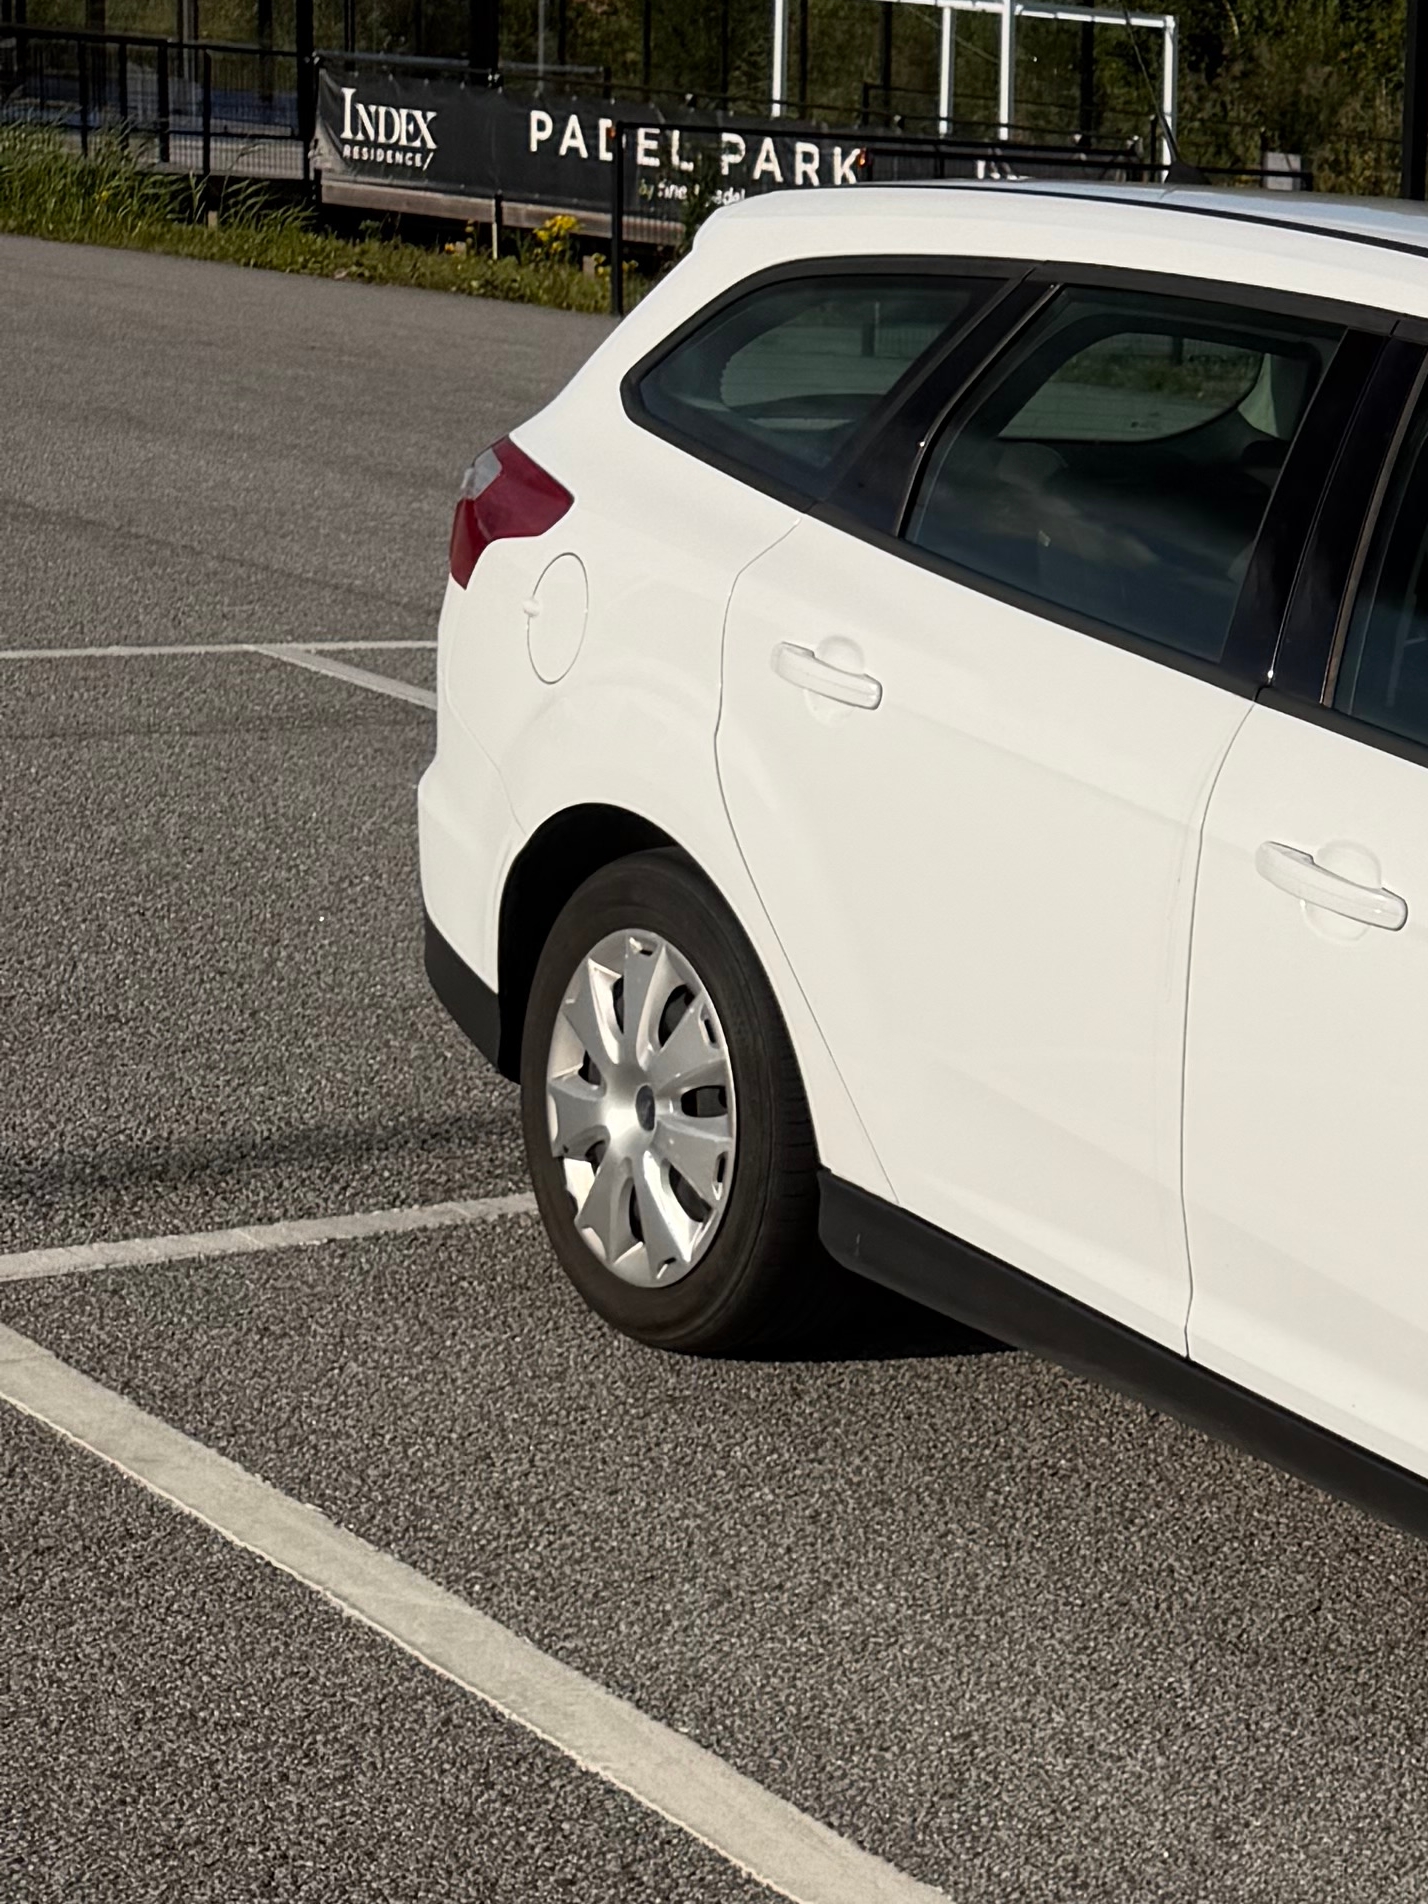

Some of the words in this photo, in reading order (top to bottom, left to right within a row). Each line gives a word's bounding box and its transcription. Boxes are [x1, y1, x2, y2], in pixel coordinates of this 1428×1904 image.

[340, 86, 438, 149] INDEX
[529, 109, 694, 172] PADEL
[720, 132, 862, 186] PARK
